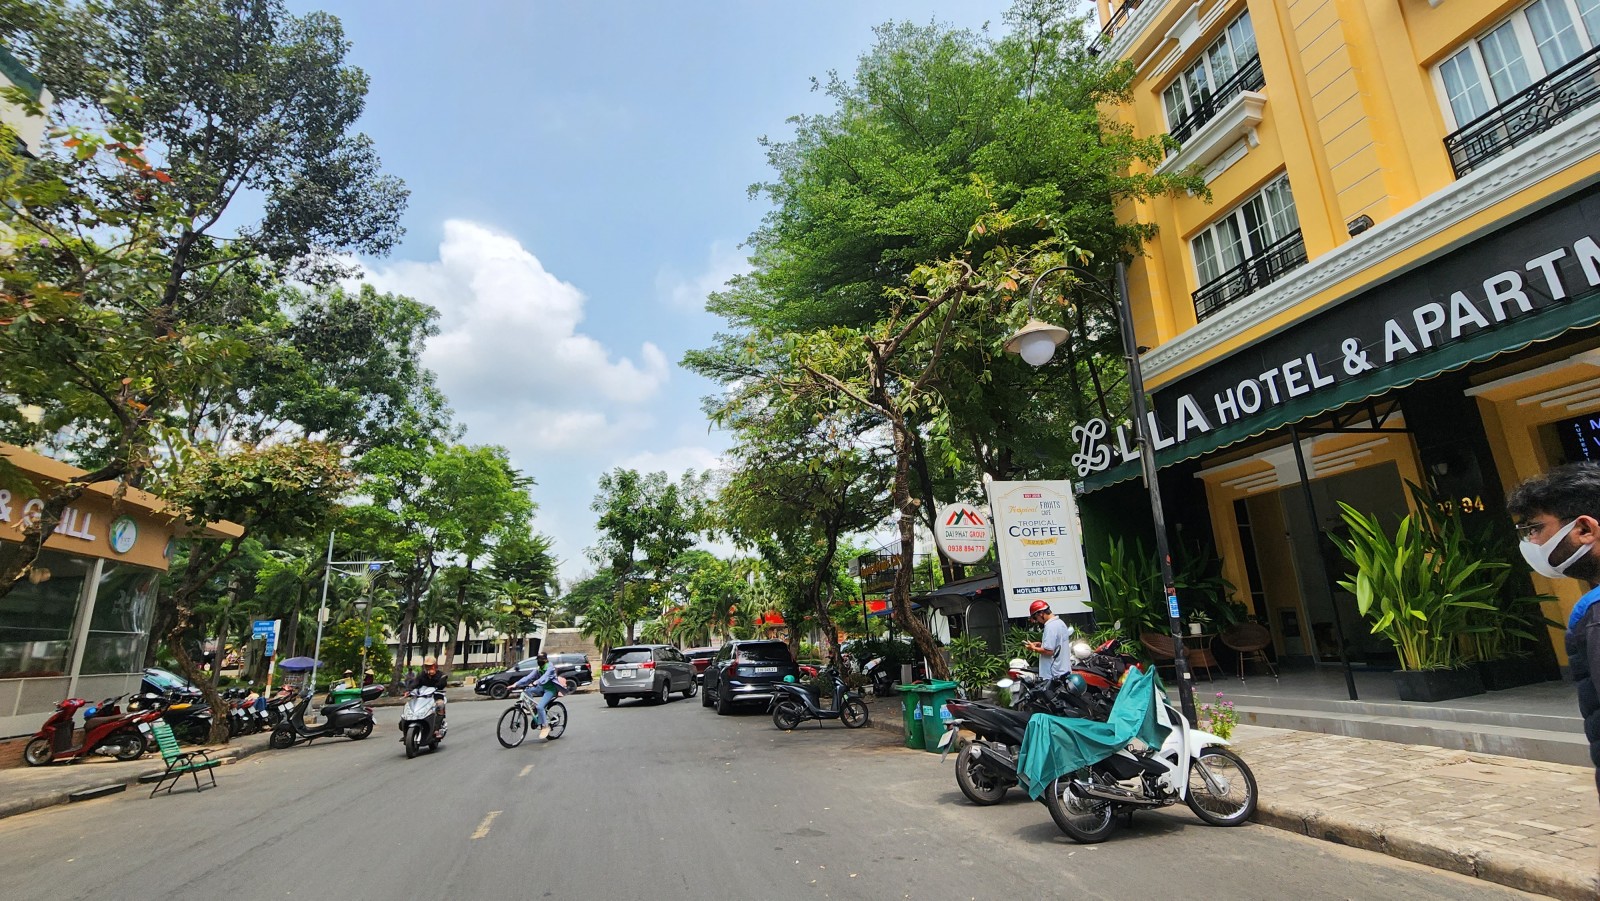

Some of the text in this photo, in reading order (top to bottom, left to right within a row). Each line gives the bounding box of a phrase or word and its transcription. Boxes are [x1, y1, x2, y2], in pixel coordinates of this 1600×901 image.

[1116, 394, 1211, 463] LLA
[1214, 353, 1335, 424] HOTEL
[1341, 337, 1373, 376] &
[22, 498, 96, 541] GILL
[1009, 526, 1067, 537] COFFEE
[969, 530, 985, 538] GROUP
